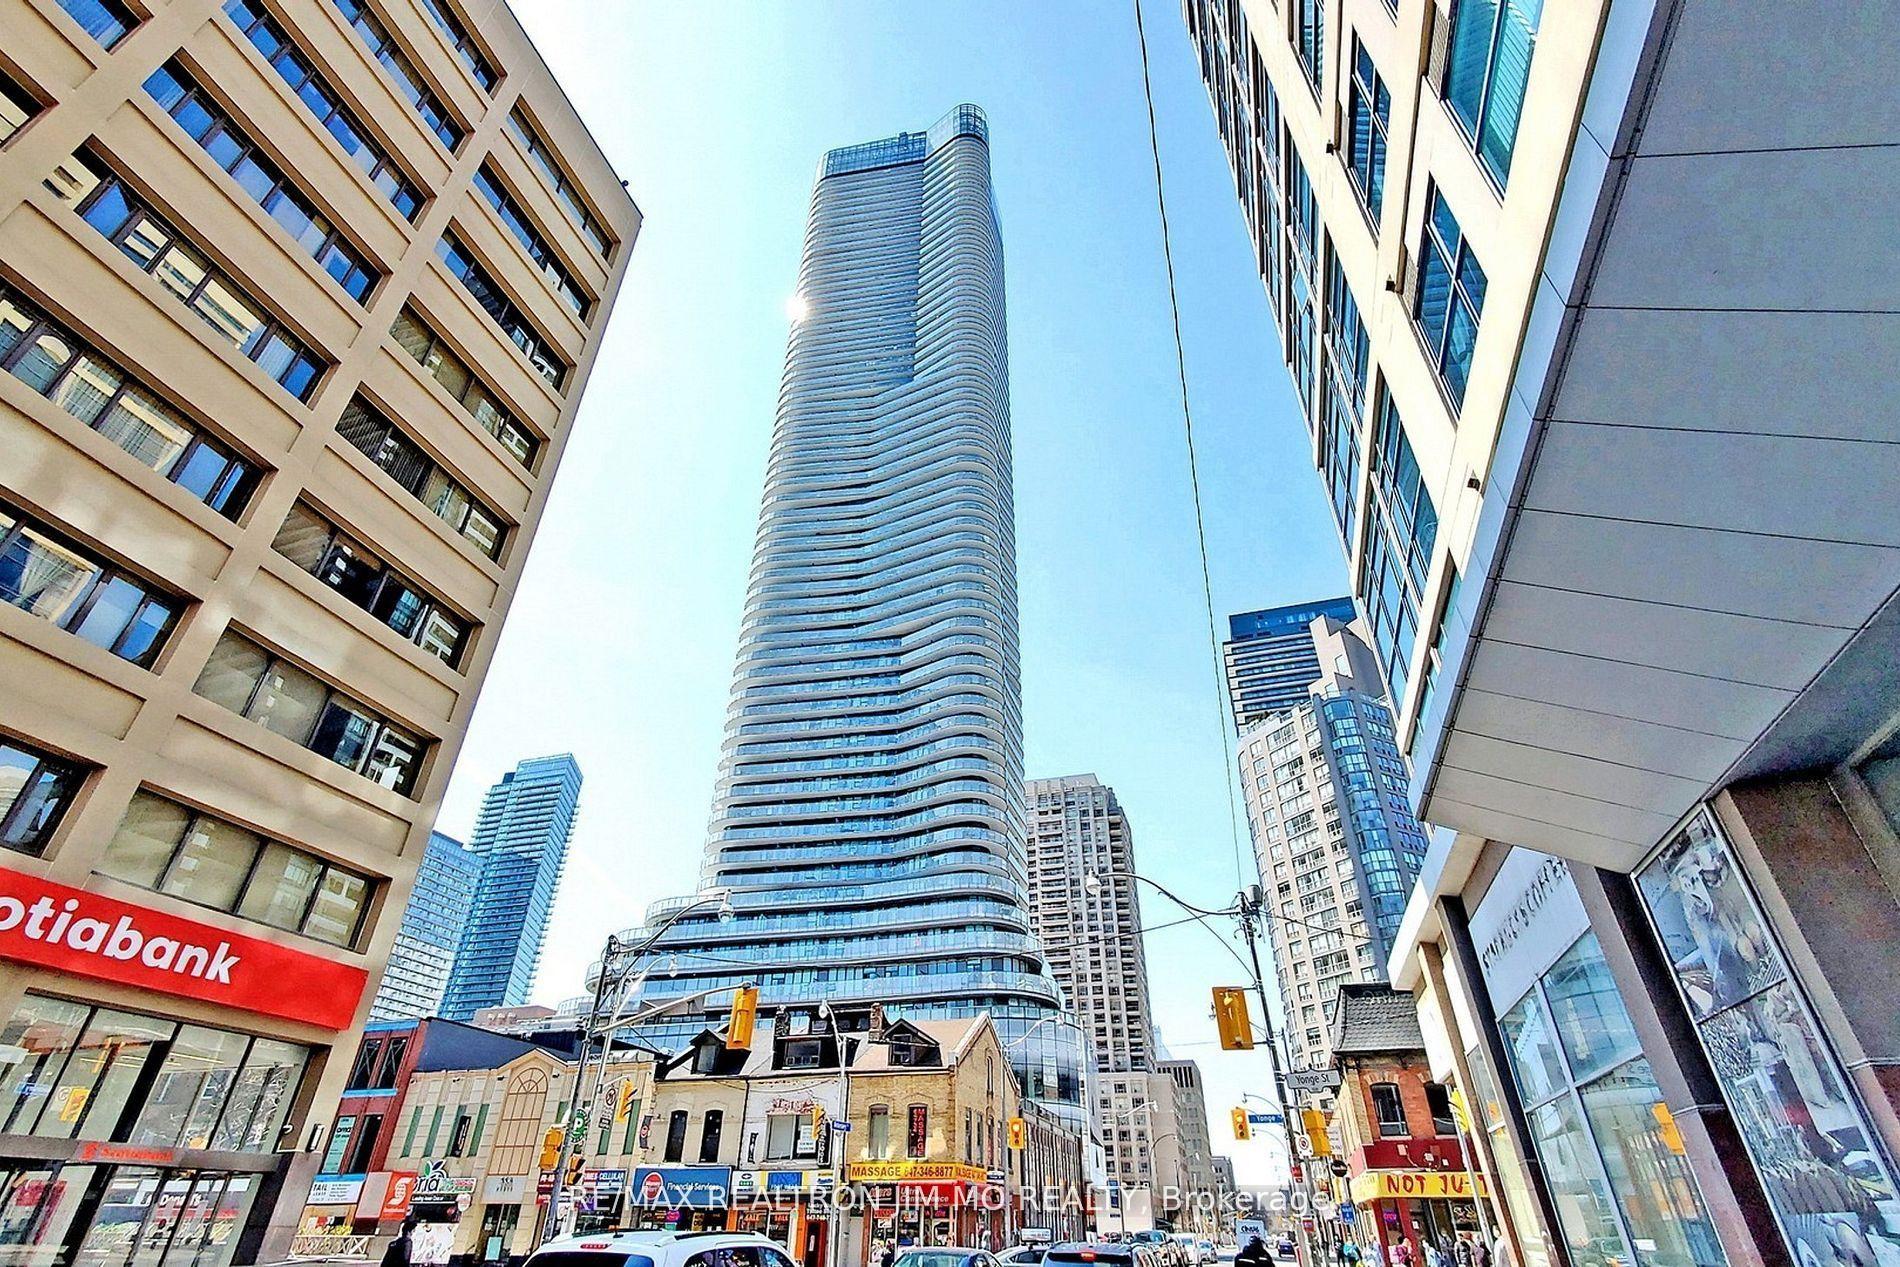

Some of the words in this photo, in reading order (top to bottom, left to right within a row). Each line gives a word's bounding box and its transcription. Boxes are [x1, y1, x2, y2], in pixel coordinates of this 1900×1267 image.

[0, 896, 241, 984] otiabank
[1295, 1075, 1320, 1085] Yonge
[1321, 1074, 1330, 1083] St
[852, 1167, 901, 1177] MASSAGE
[1387, 1174, 1426, 1194] NOT
